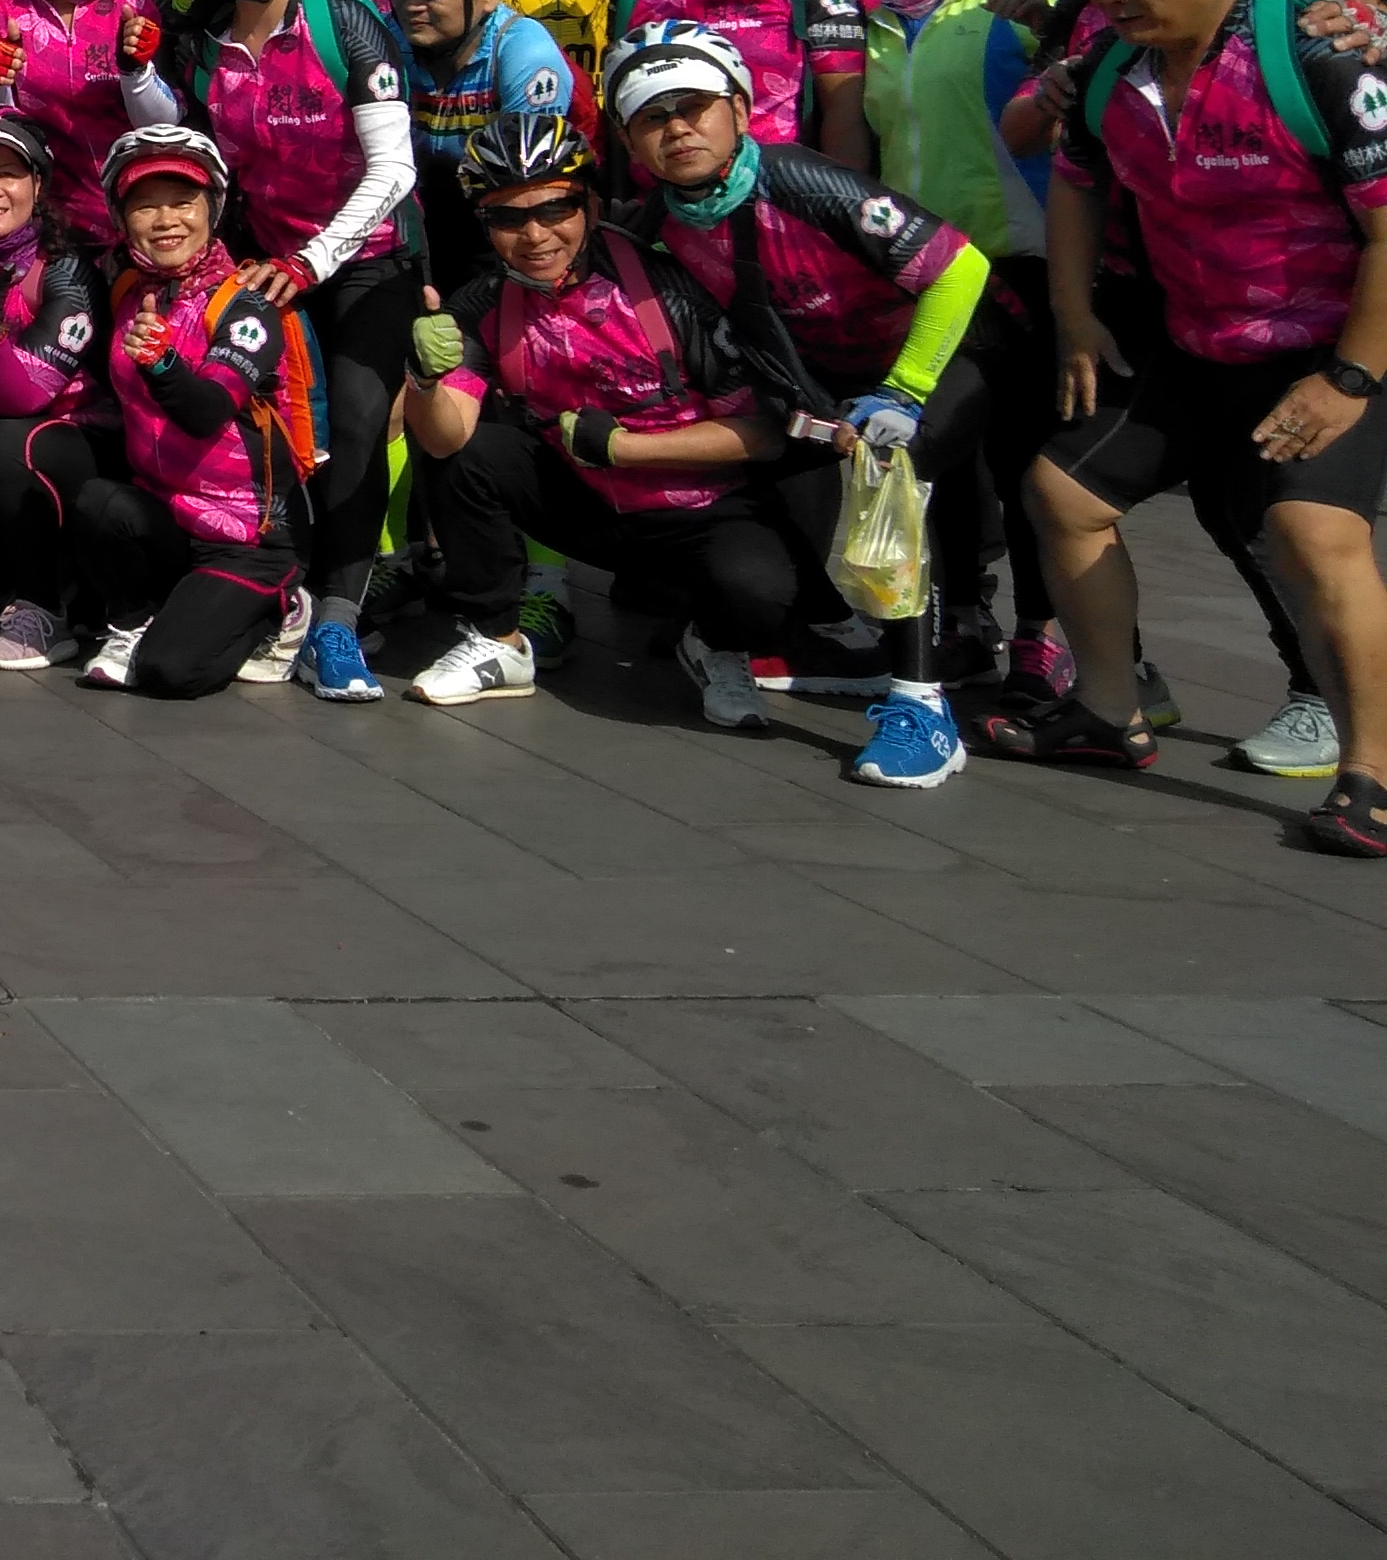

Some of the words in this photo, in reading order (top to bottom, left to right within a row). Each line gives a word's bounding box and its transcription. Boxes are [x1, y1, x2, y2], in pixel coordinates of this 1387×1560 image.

[646, 62, 678, 77] PUMA
[267, 114, 301, 126] Cycling
[1195, 153, 1240, 170] Cycling
[1241, 153, 1270, 166] bike
[634, 381, 661, 392] bike
